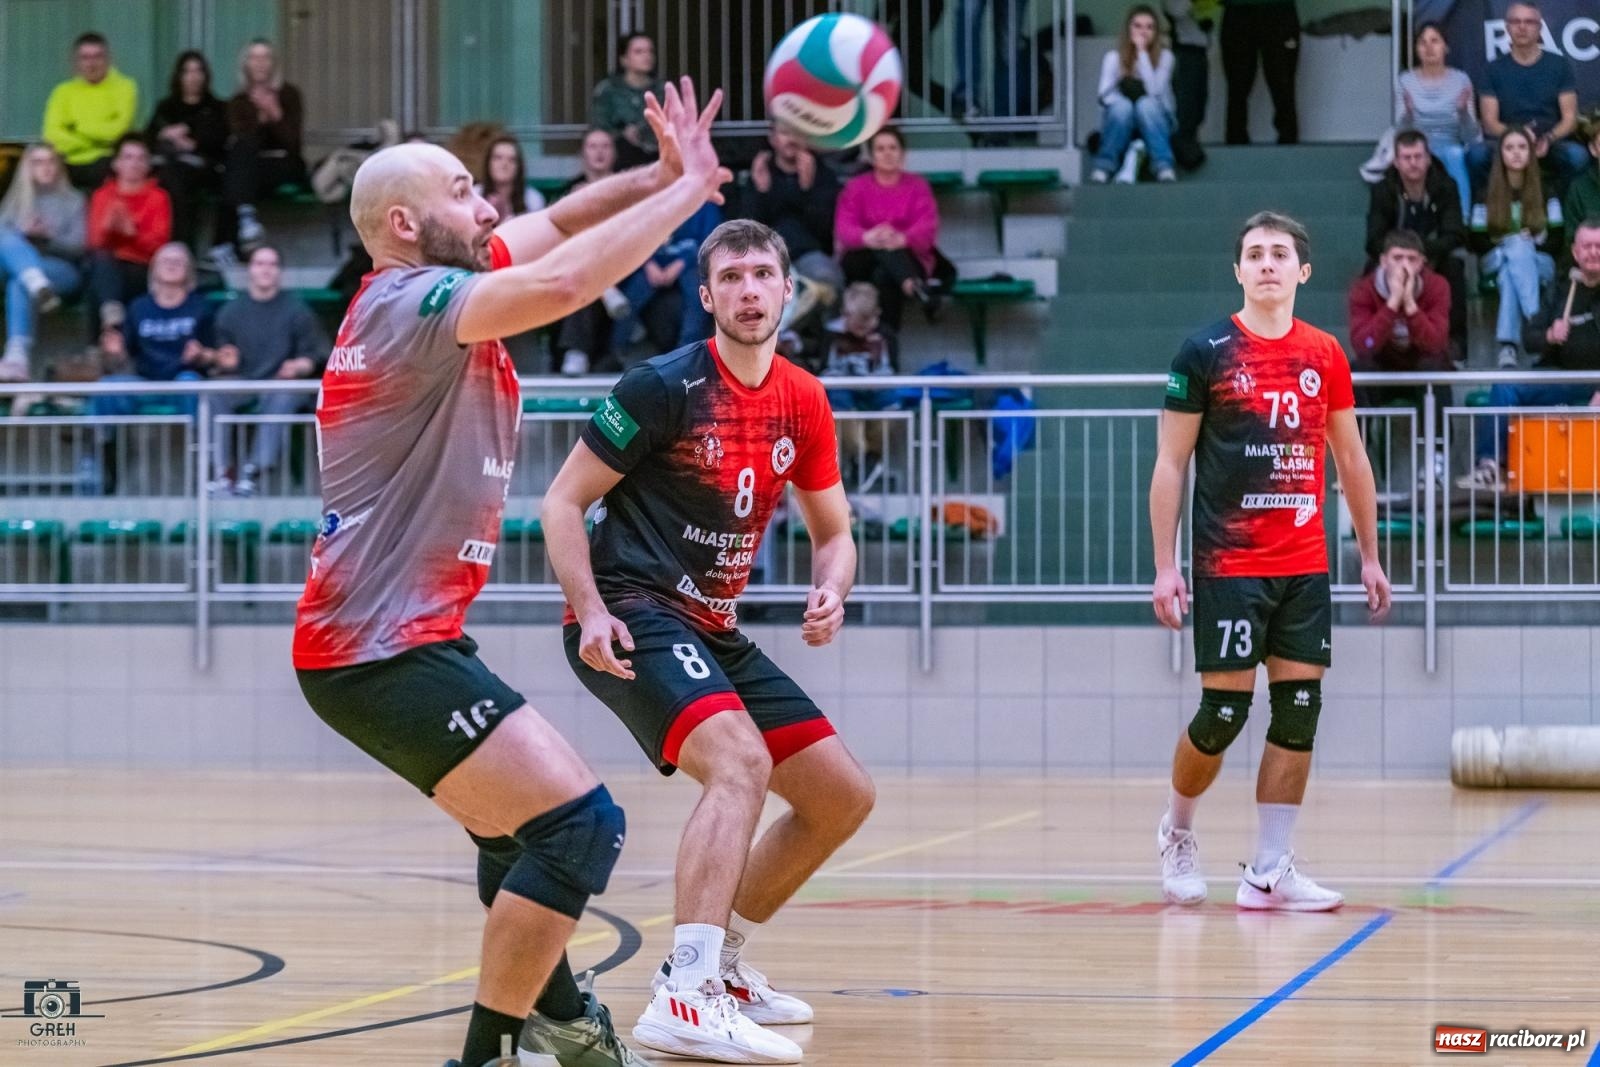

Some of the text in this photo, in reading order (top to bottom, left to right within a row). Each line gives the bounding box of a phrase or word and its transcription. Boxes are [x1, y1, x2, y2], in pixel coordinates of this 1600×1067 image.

[1263, 391, 1300, 429] 73
[734, 468, 755, 518] 8
[705, 568, 732, 584] dobry
[1217, 619, 1253, 658] 73
[673, 643, 711, 679] 8
